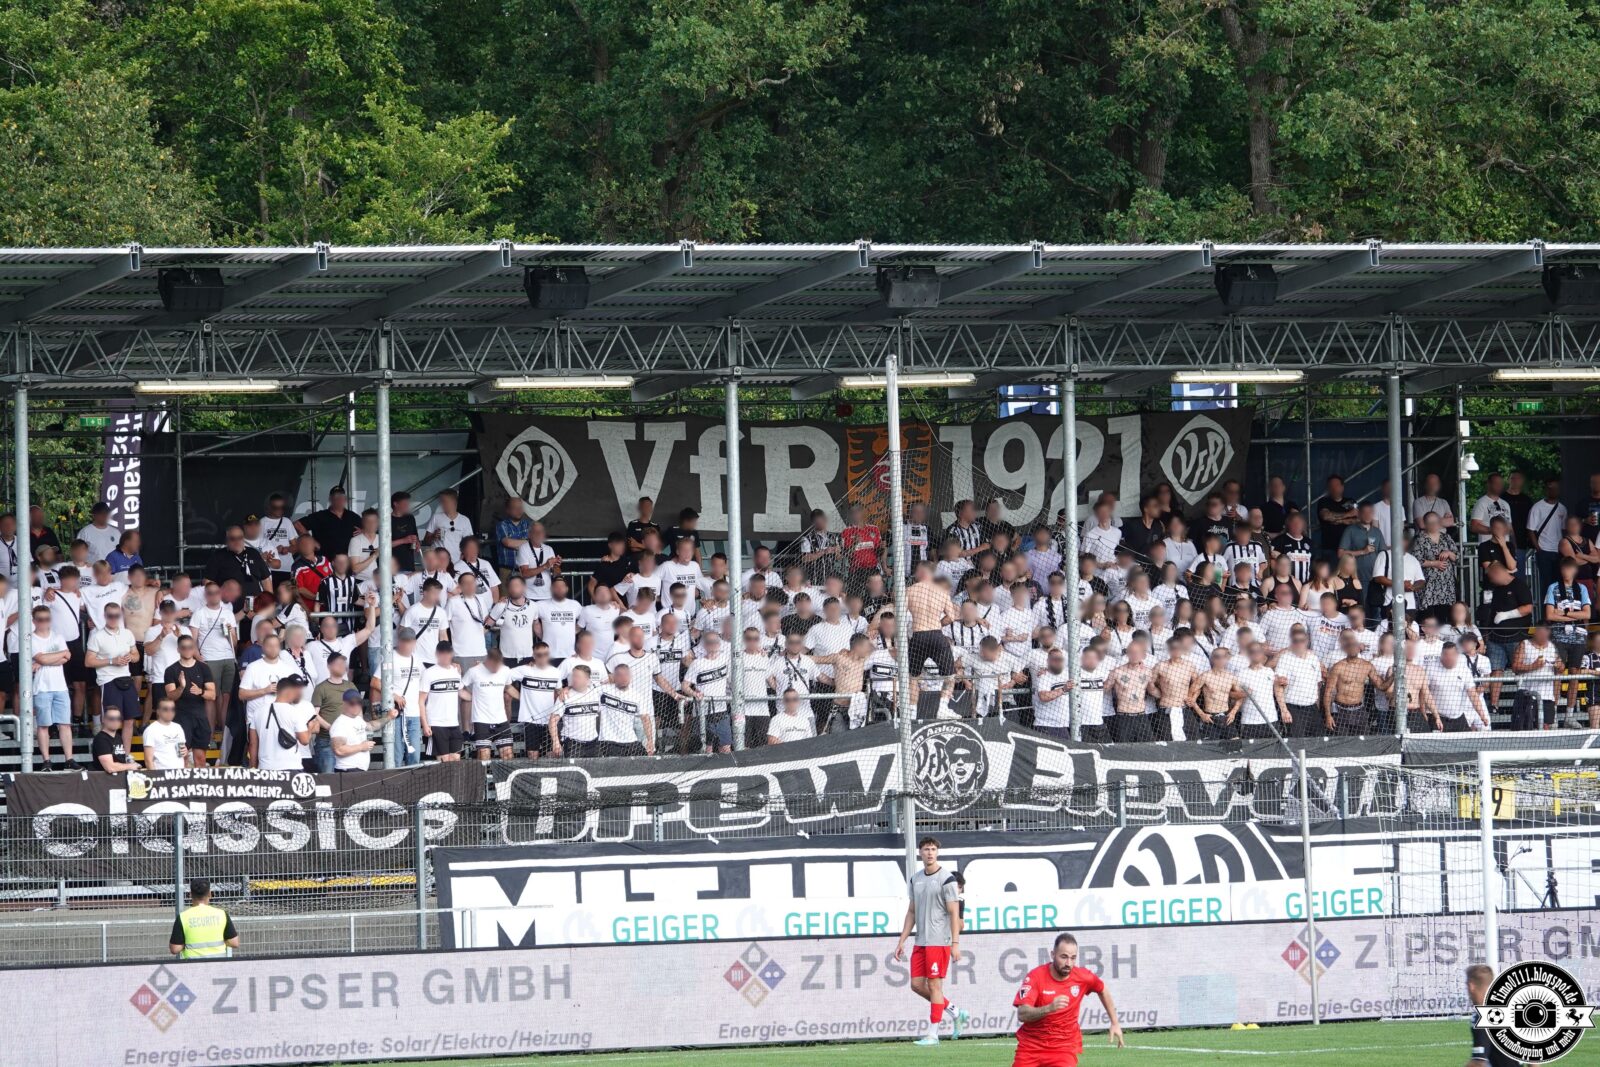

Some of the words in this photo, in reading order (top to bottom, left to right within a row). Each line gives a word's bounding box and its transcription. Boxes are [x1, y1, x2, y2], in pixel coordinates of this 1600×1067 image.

[587, 420, 847, 534] VfR
[938, 413, 1142, 529] 1921
[193, 768, 222, 780] SOLL
[224, 768, 251, 780] MAN
[253, 768, 291, 782] SONST
[150, 786, 169, 799] AM
[172, 784, 225, 798] SAMSTAG
[32, 788, 458, 858] classics
[961, 904, 1058, 931] GEIGER
[1121, 897, 1223, 927] GEIGER
[1285, 888, 1384, 918] GEIGER
[188, 915, 220, 929] SECURITY
[612, 912, 720, 942] GEIGER
[784, 910, 889, 937] GEIGER
[1354, 927, 1522, 970] ZIPSER
[800, 948, 976, 991] ZIPSR
[930, 962, 939, 973] 4
[211, 970, 400, 1015] ZIPSER
[422, 963, 572, 1005] GMBH
[718, 1016, 953, 1042] Energie-Gesamtkonzepe:
[125, 1039, 374, 1067] Energie-Gesamtkonzepte:
[381, 1030, 592, 1054] Solar/Elektro/Heizung
